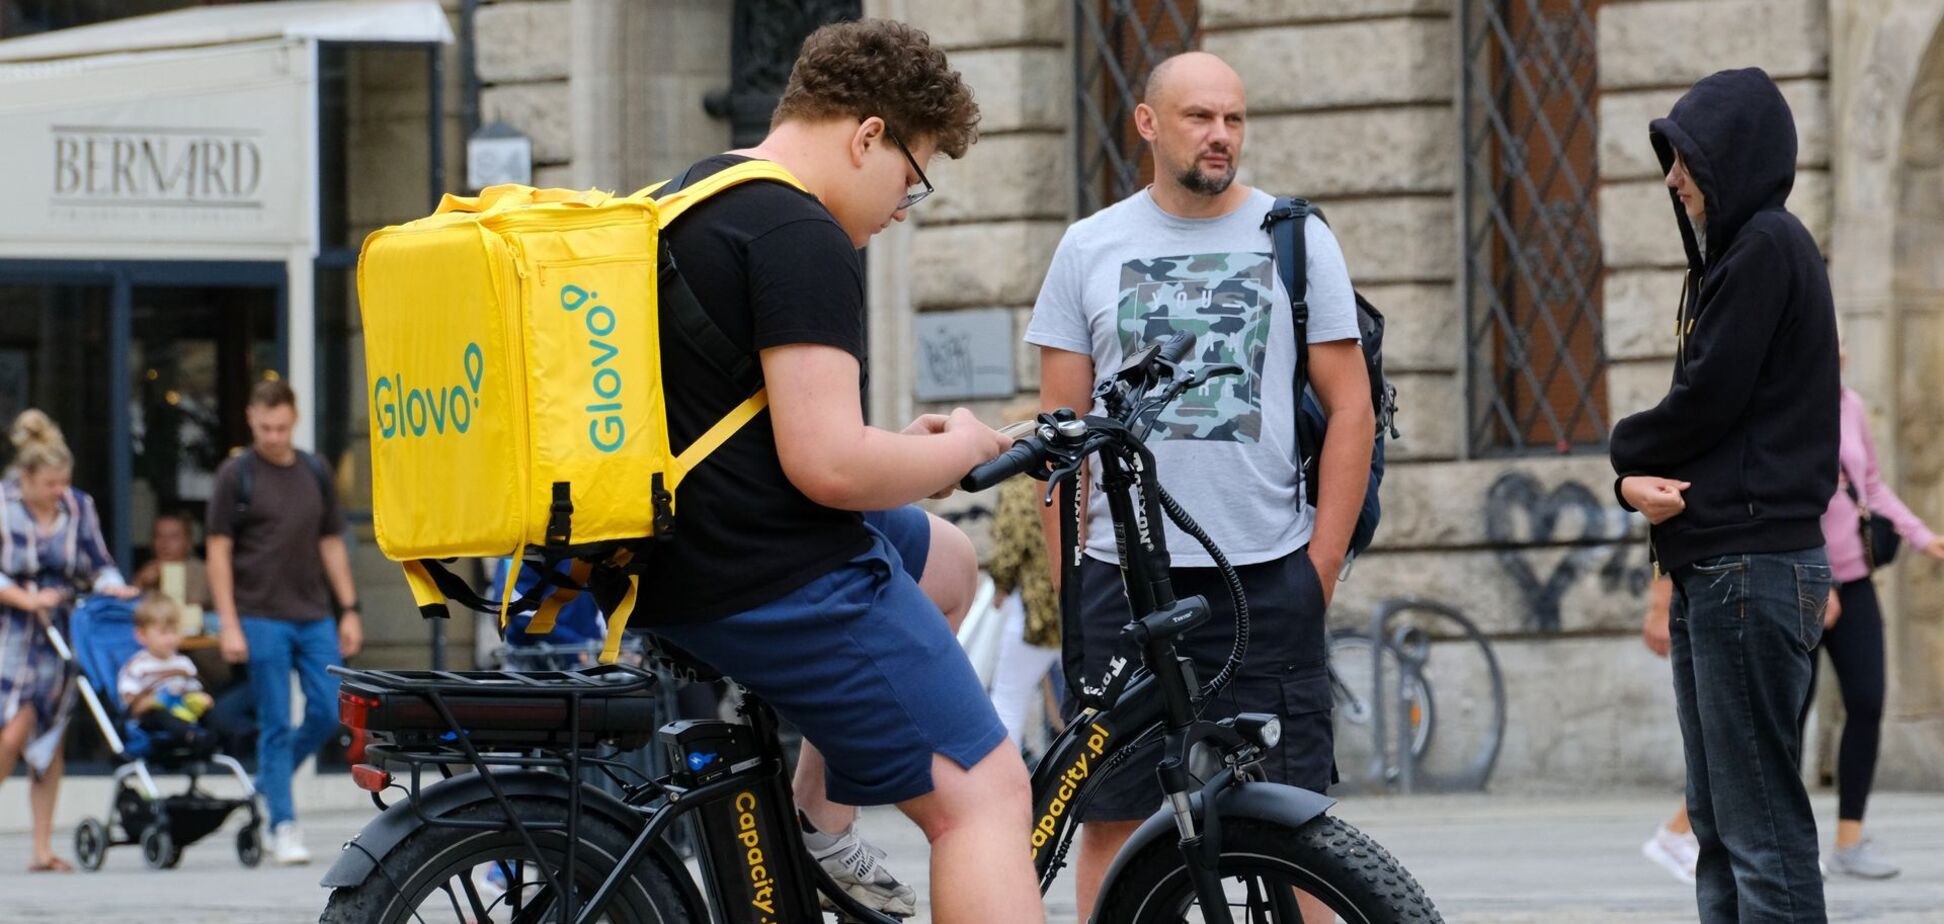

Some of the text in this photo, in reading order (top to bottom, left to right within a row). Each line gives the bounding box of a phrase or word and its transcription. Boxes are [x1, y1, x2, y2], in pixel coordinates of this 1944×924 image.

[54, 137, 262, 200] BERNARD
[736, 791, 776, 924] Capacity.
[1031, 723, 1110, 860] apacity.pl
